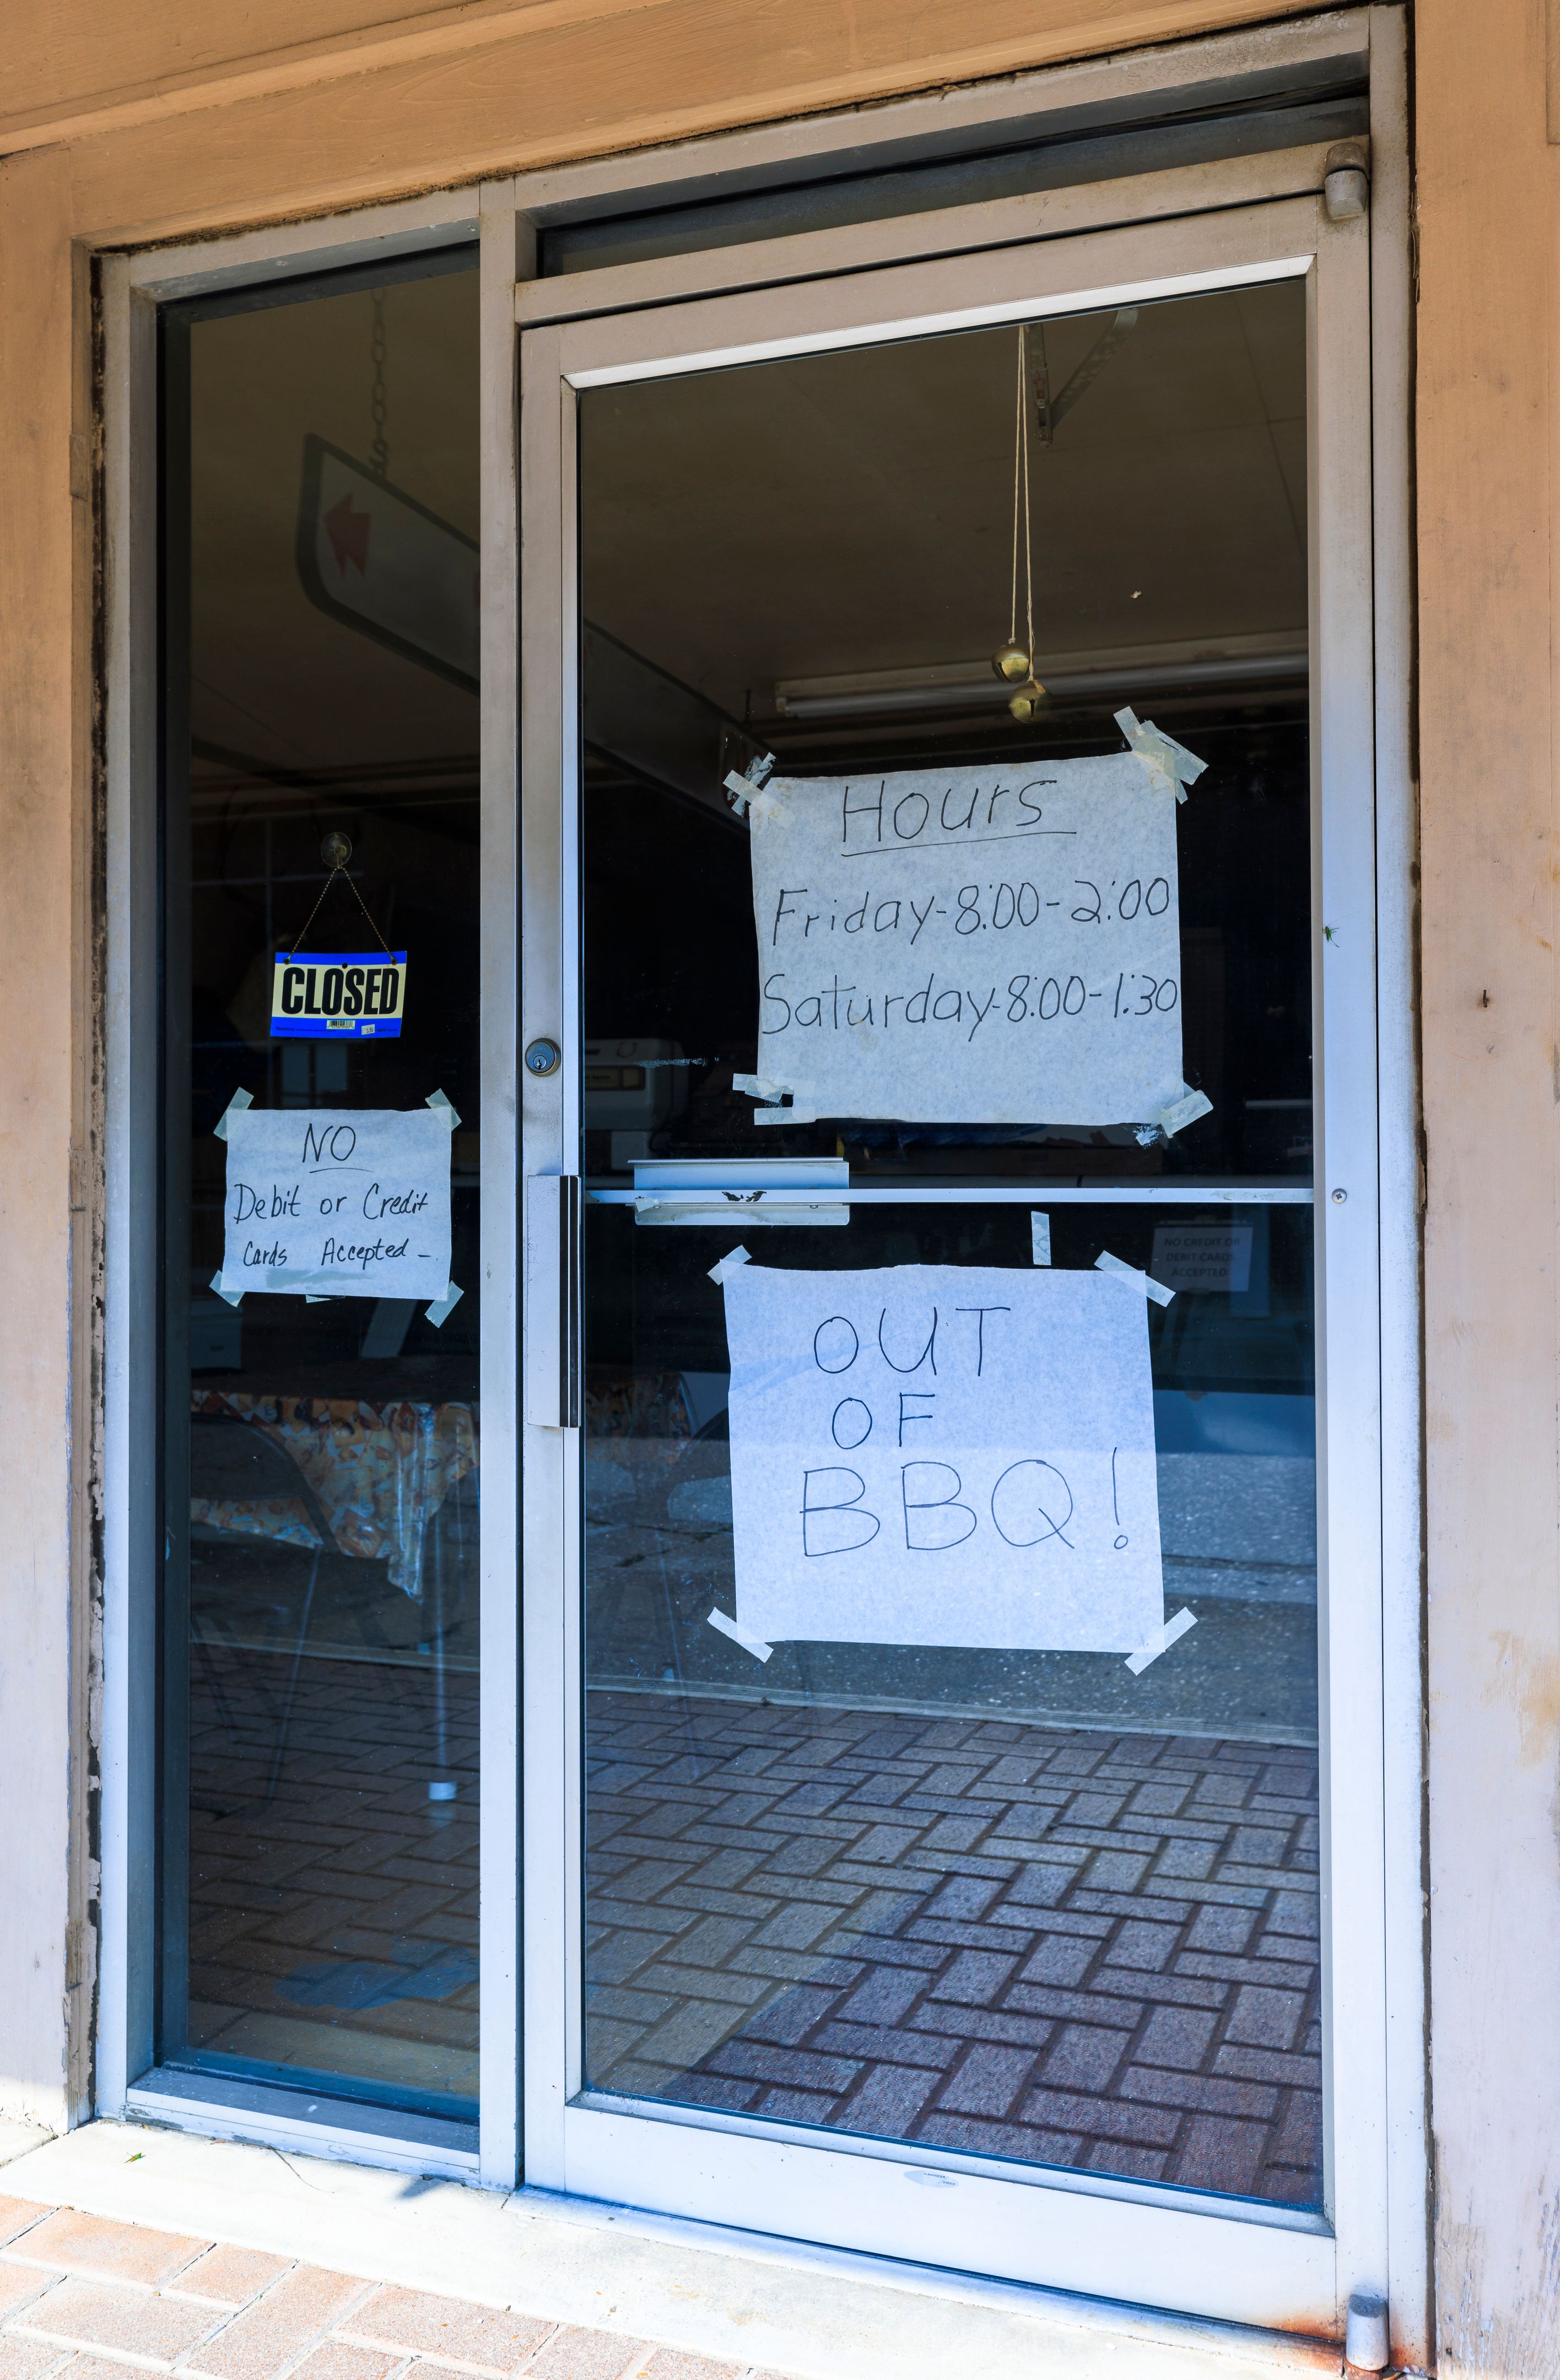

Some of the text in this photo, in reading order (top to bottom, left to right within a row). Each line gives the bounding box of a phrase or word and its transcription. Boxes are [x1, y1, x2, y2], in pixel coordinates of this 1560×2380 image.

[843, 779, 1057, 844] Hours
[282, 967, 400, 1016] CLOSED
[302, 1123, 356, 1163] NO
[233, 1182, 428, 1225] Debit or Credit
[242, 1241, 288, 1267] Cards
[321, 1237, 409, 1270] Accepted
[1166, 1253, 1235, 1261] DEBIT CARDS
[1172, 1268, 1227, 1276] ACCEPTED
[813, 1306, 1012, 1377] OUT
[832, 1392, 936, 1450] OF
